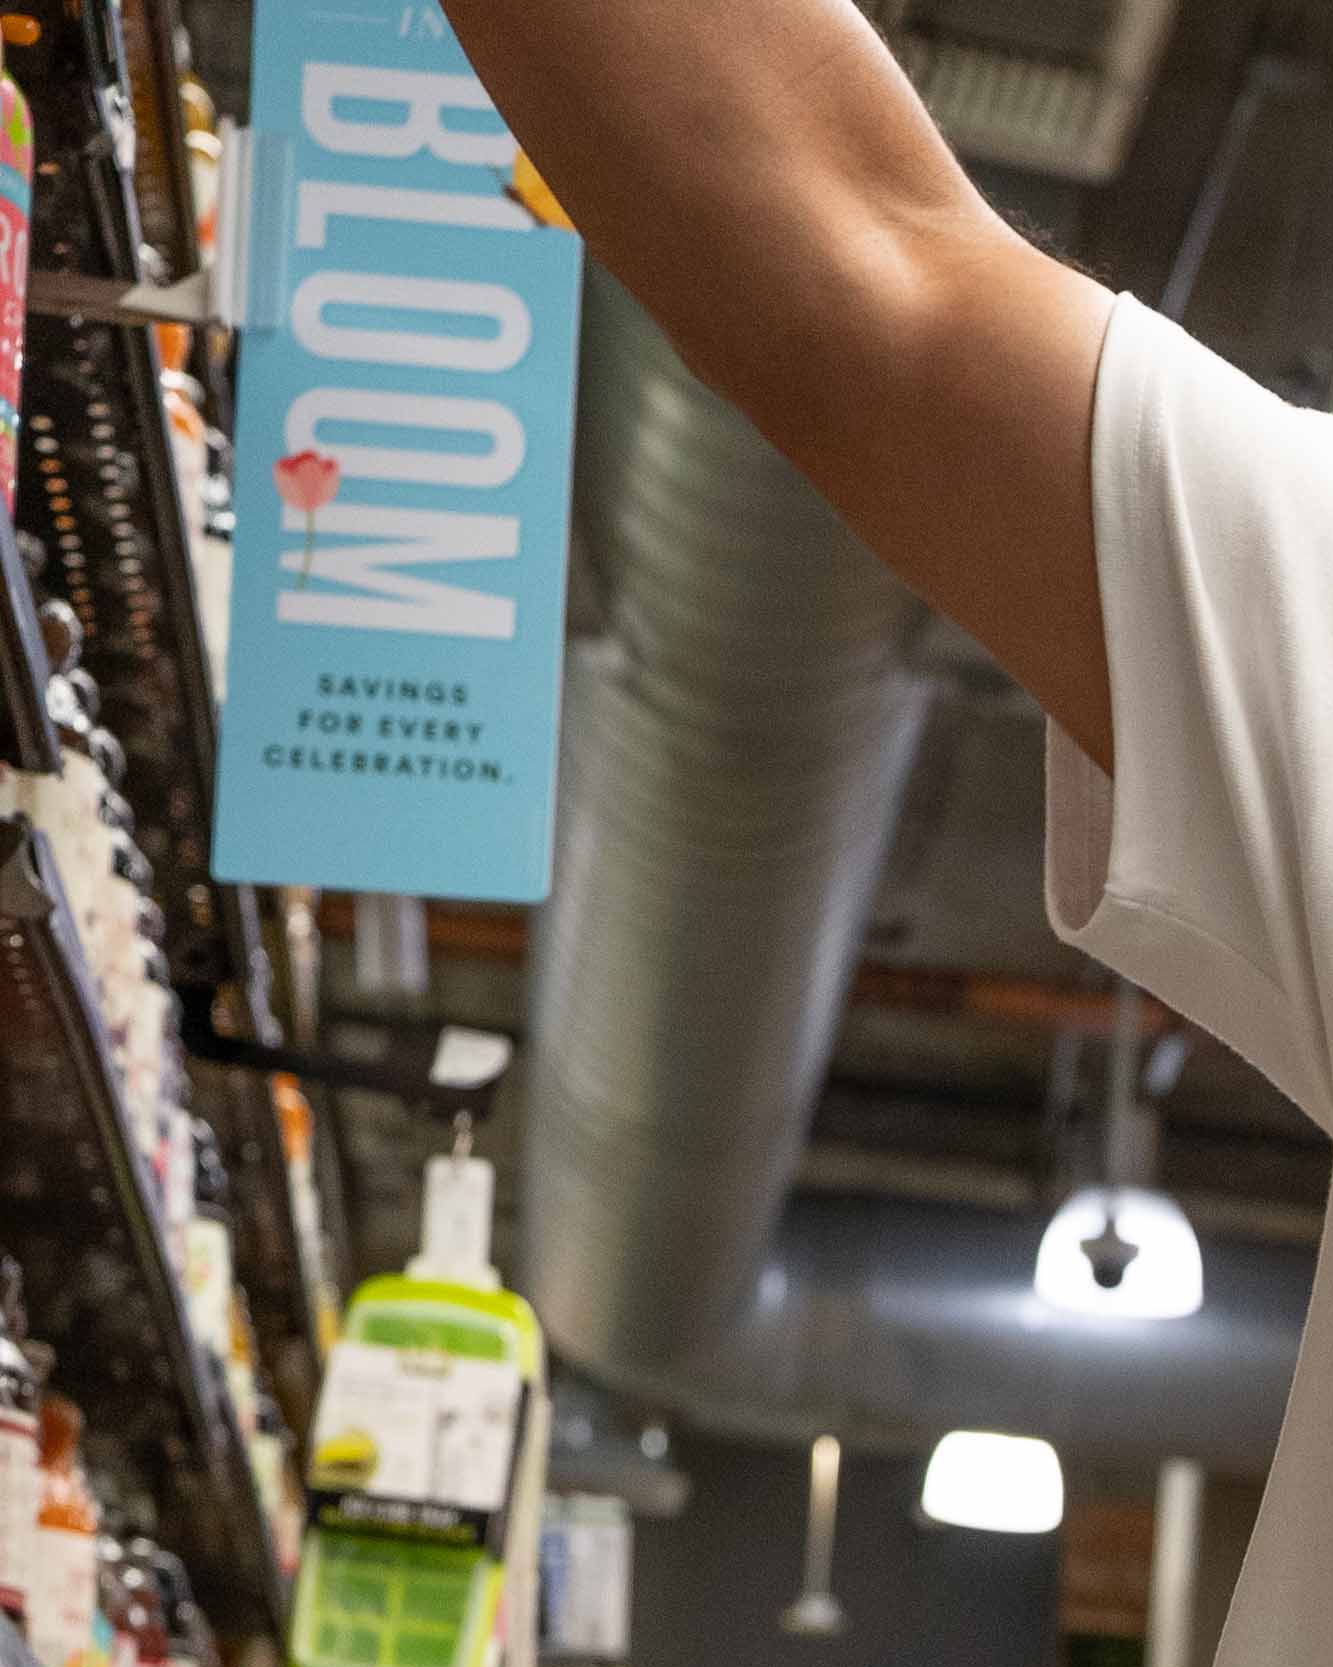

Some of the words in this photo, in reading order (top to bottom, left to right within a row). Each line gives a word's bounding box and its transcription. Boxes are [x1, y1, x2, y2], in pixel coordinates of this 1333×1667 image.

[275, 61, 541, 641] BLOOM
[318, 673, 468, 706] SAVINGS
[298, 708, 362, 736] FOR
[377, 715, 483, 743] EVERY
[262, 744, 513, 785] CELEBRATION.
